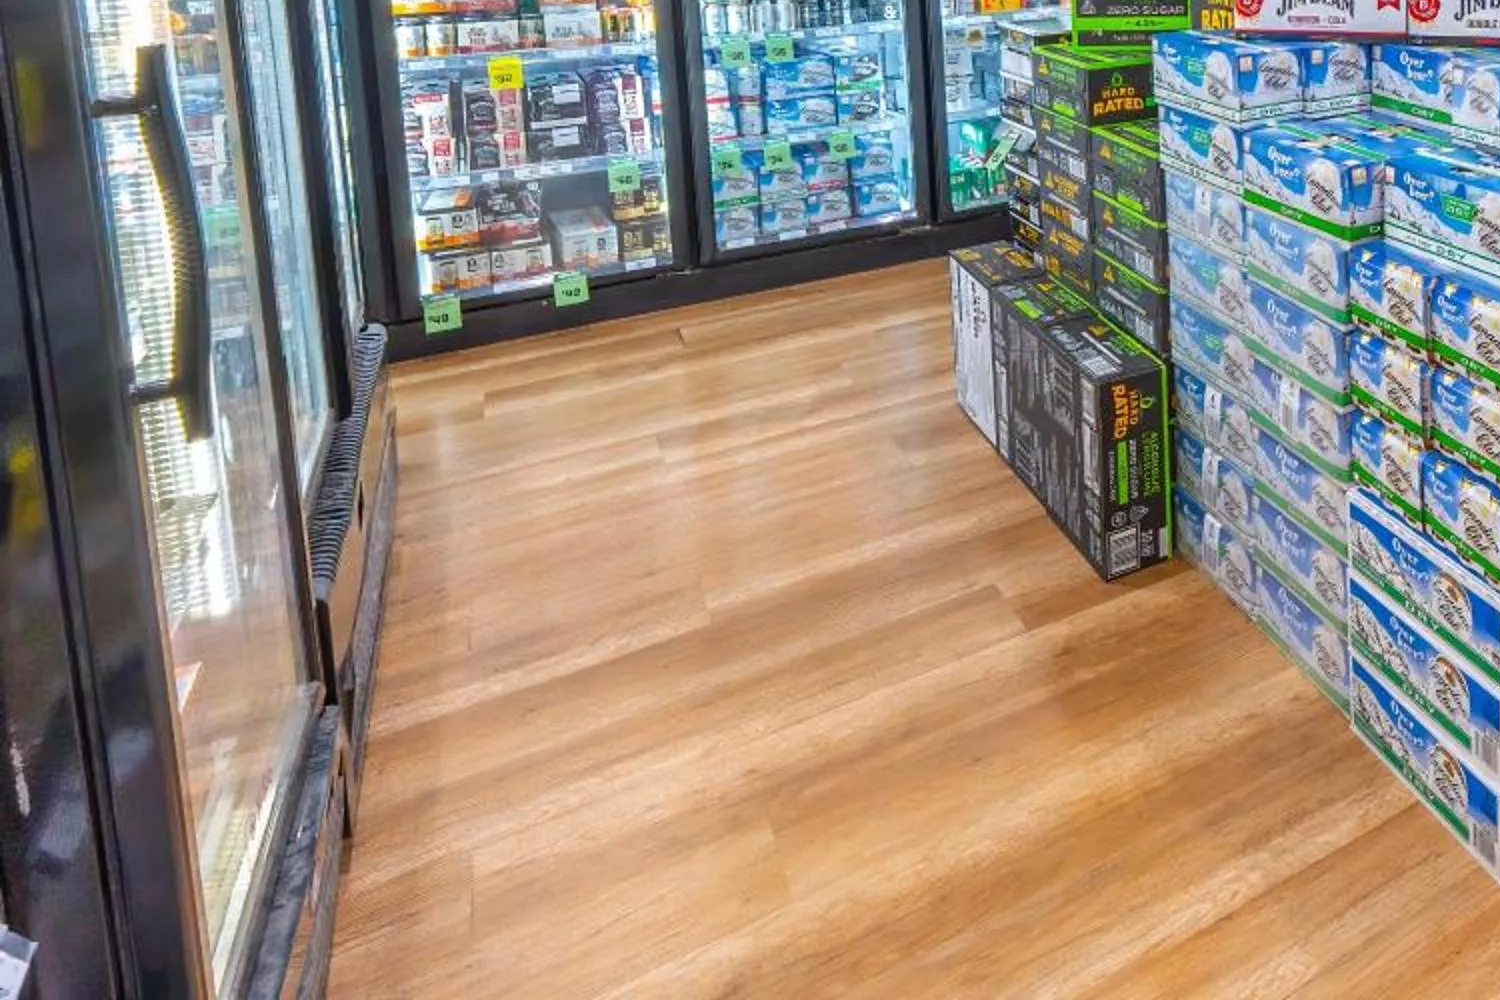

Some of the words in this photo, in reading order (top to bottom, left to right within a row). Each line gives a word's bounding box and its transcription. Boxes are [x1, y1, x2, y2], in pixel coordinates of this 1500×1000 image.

[1142, 5, 1185, 15] SUGAR
[1201, 9, 1234, 31] RAT
[1399, 52, 1425, 69] Over
[1092, 97, 1144, 117] RATED
[1267, 146, 1292, 166] Over
[1403, 171, 1428, 191] Over
[1111, 383, 1128, 441] RATED
[1391, 536, 1419, 563] Over
[1402, 599, 1440, 631] DRY
[1389, 615, 1416, 643] Over
[1389, 699, 1416, 730] Over
